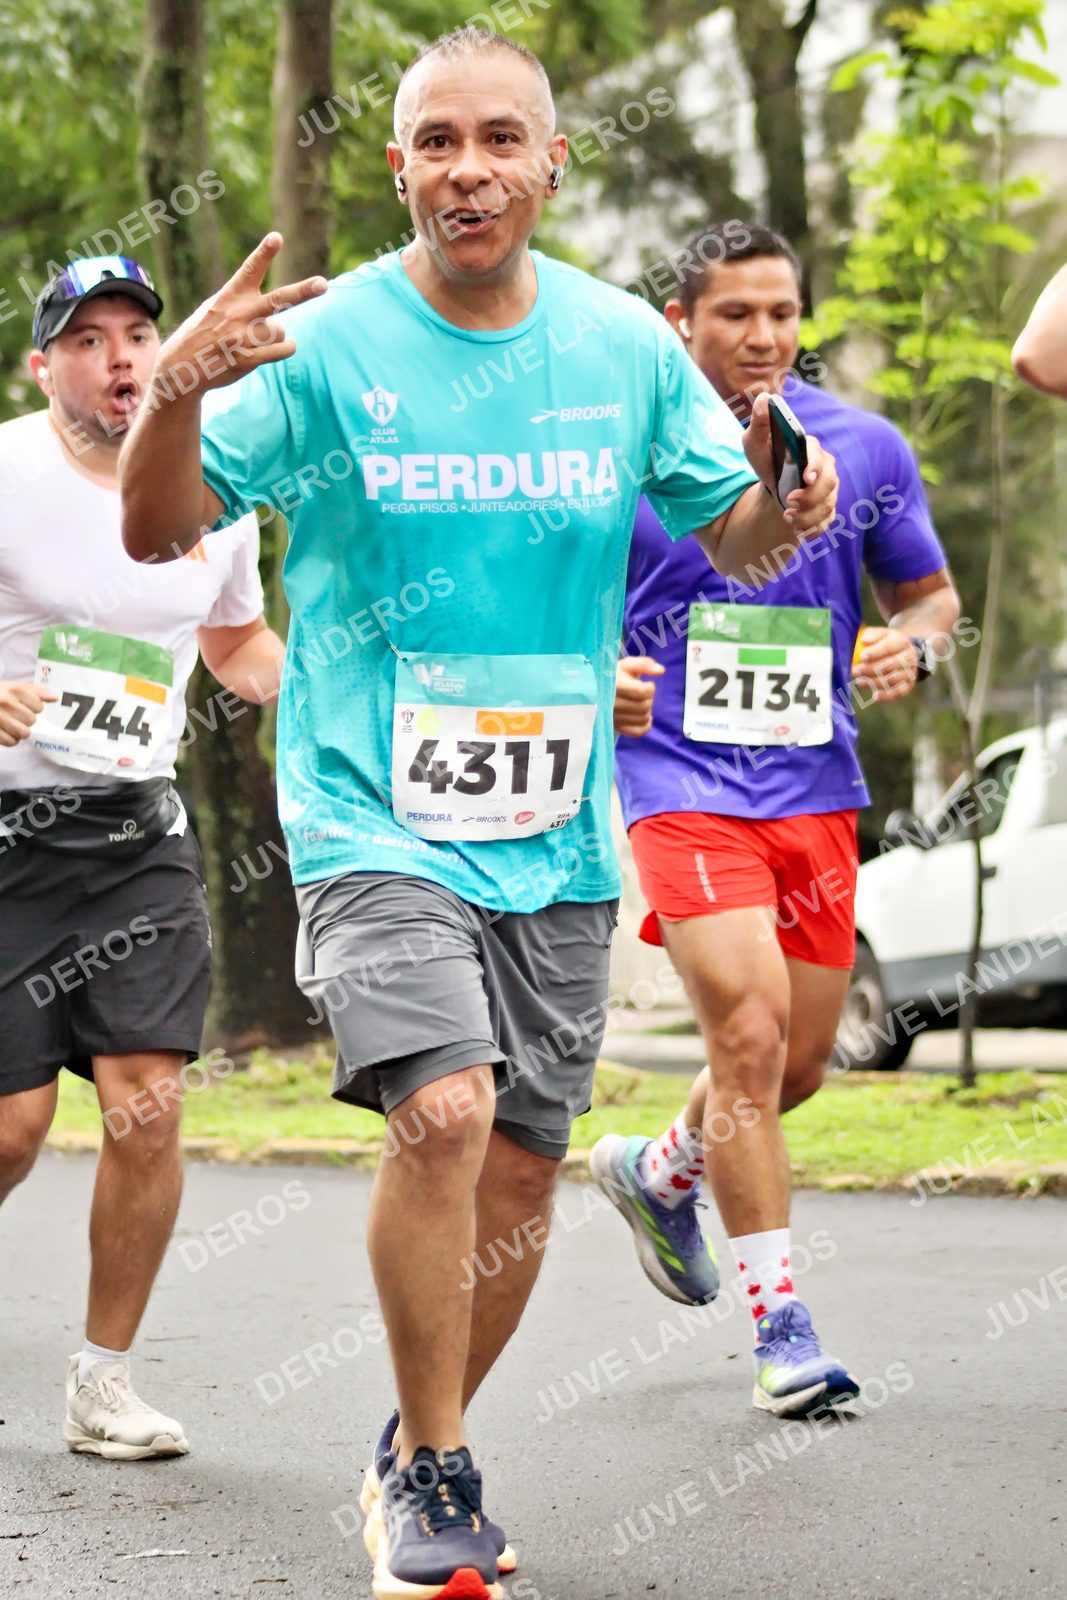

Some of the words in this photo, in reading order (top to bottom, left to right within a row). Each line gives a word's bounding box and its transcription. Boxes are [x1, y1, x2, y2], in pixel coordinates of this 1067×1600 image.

[559, 404, 621, 423] BROOKS
[370, 436, 399, 444] ATLAS
[363, 448, 618, 500] PERDURA
[382, 503, 416, 514] PEGA
[420, 503, 458, 513] PISOS
[467, 499, 557, 514] JUNTEADORES
[698, 668, 820, 712] 2134
[61, 692, 152, 746] 744
[408, 739, 570, 796] 4311
[407, 811, 453, 822] PERDURA
[476, 815, 507, 823] BROOKS
